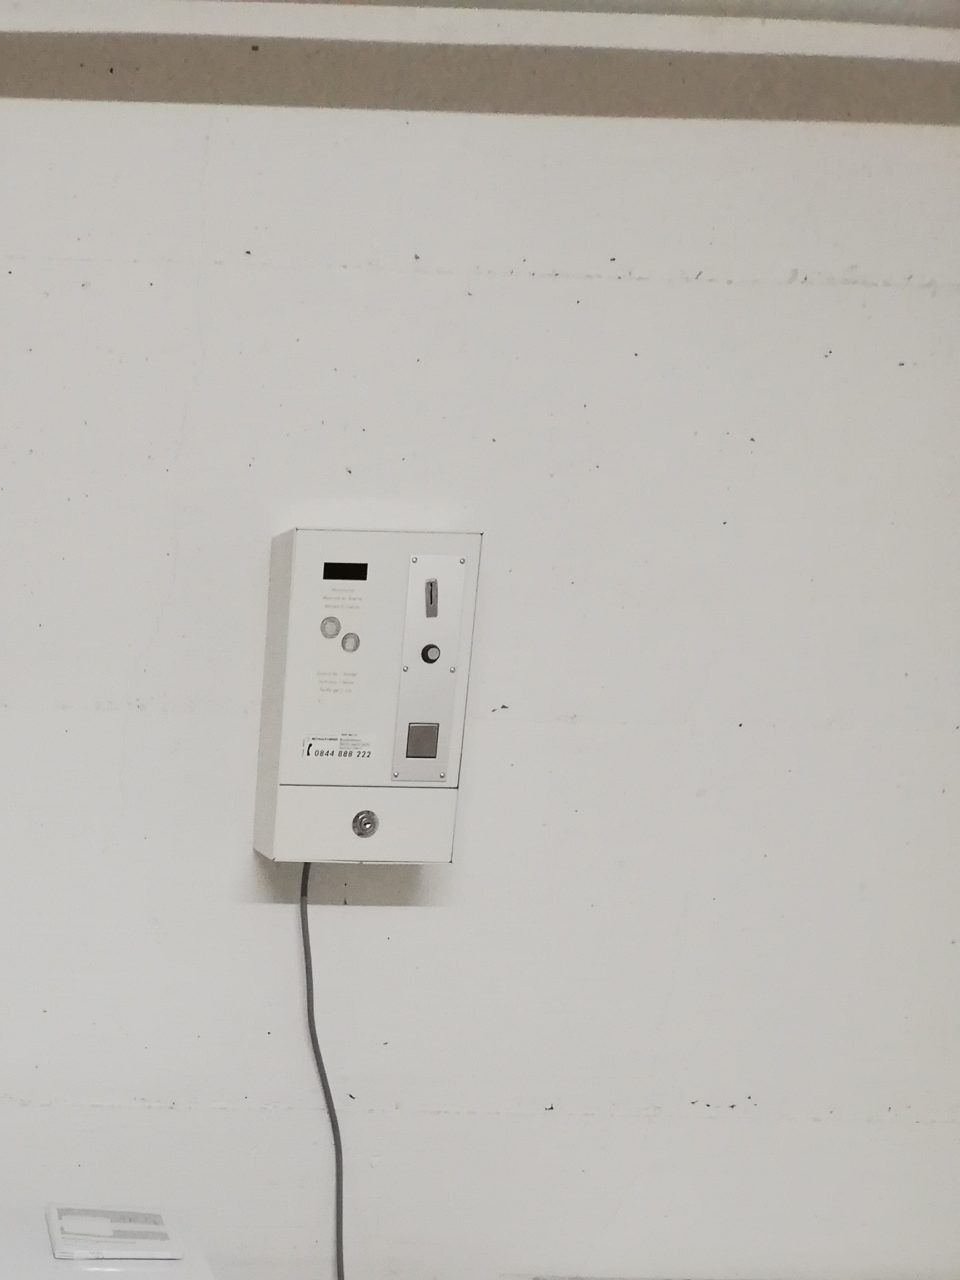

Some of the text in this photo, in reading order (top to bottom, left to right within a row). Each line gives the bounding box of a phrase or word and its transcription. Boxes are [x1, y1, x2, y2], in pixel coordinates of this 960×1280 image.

[314, 749, 372, 758] 0844 888 222
